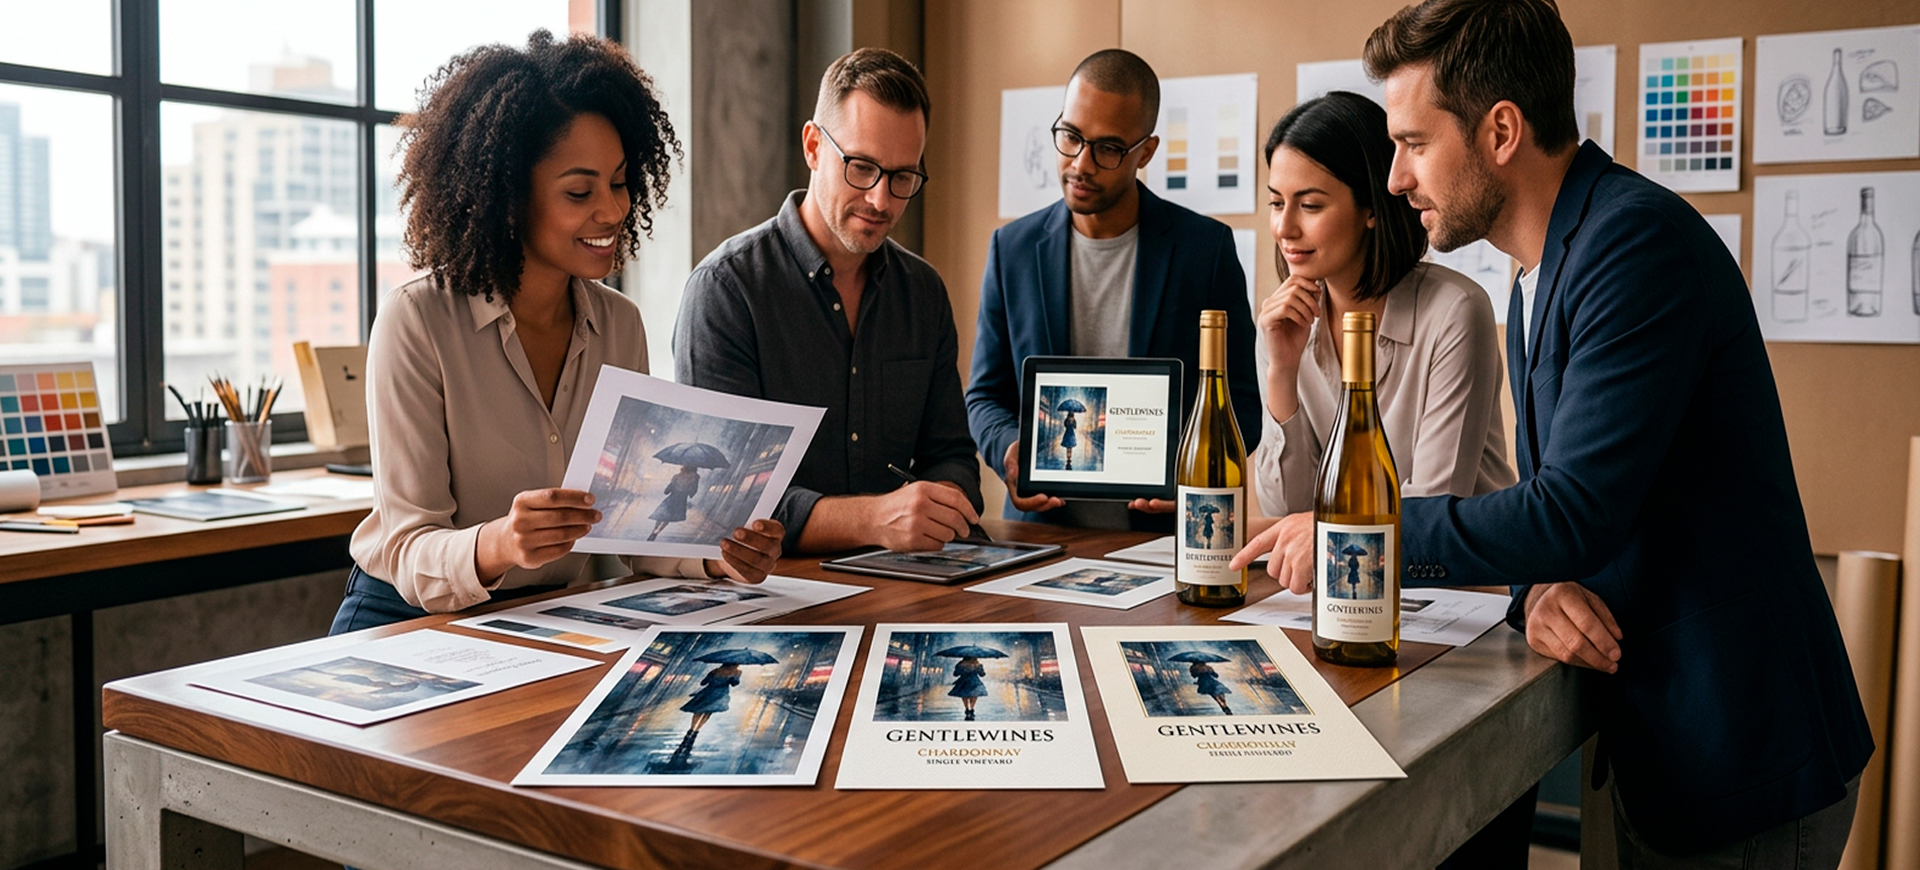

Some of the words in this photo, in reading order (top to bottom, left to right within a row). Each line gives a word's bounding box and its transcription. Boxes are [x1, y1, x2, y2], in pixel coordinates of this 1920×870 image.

[886, 729, 1054, 742] GENTLEWINES
[1157, 722, 1321, 737] GENTLEWINES
[917, 748, 1022, 758] CHARDONNAY
